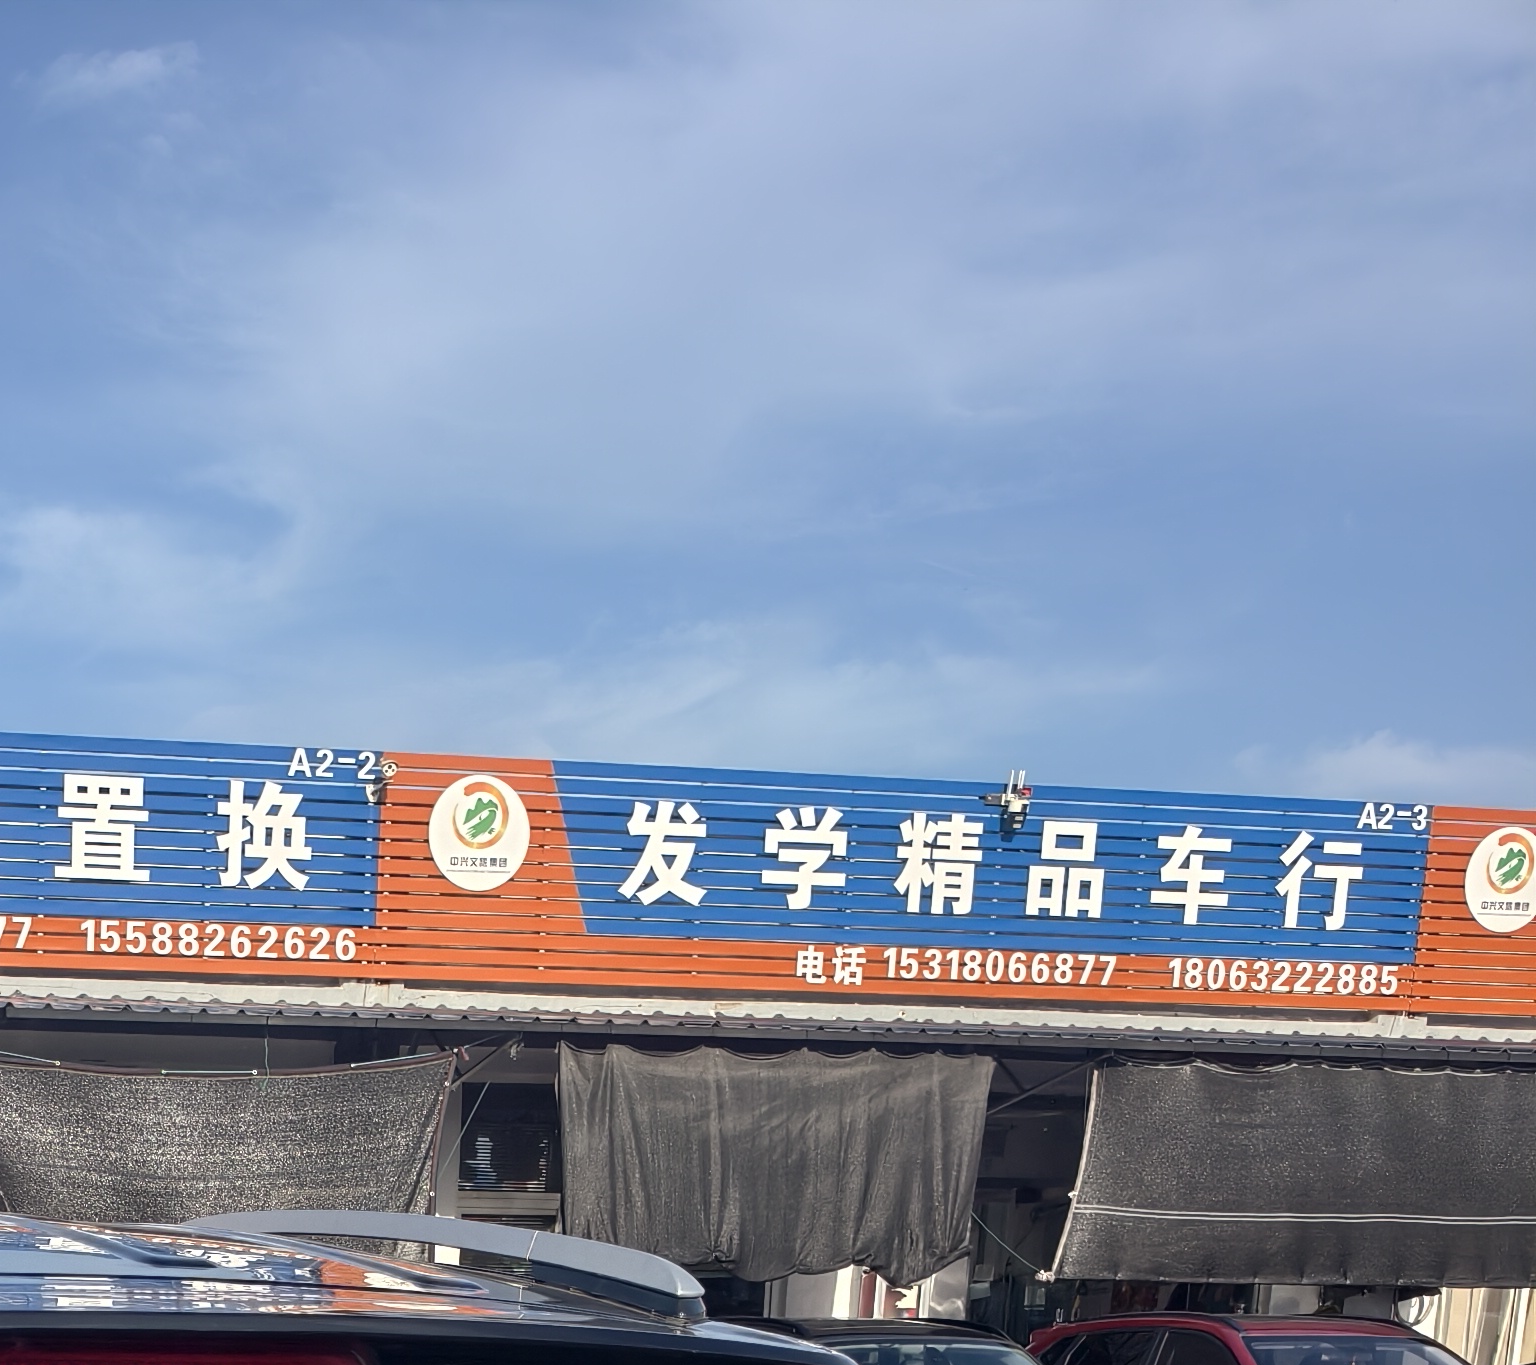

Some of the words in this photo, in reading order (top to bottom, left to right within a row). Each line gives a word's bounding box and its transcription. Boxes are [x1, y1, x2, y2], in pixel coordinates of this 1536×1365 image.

[287, 747, 376, 780] A2-2
[1357, 803, 1428, 831] A2-3
[618, 801, 1363, 931] 发学精品车行
[80, 919, 356, 962] 15588262626
[795, 945, 866, 985] 电话
[883, 948, 1117, 986] 15318066877
[1168, 958, 1398, 996] 18063222885
